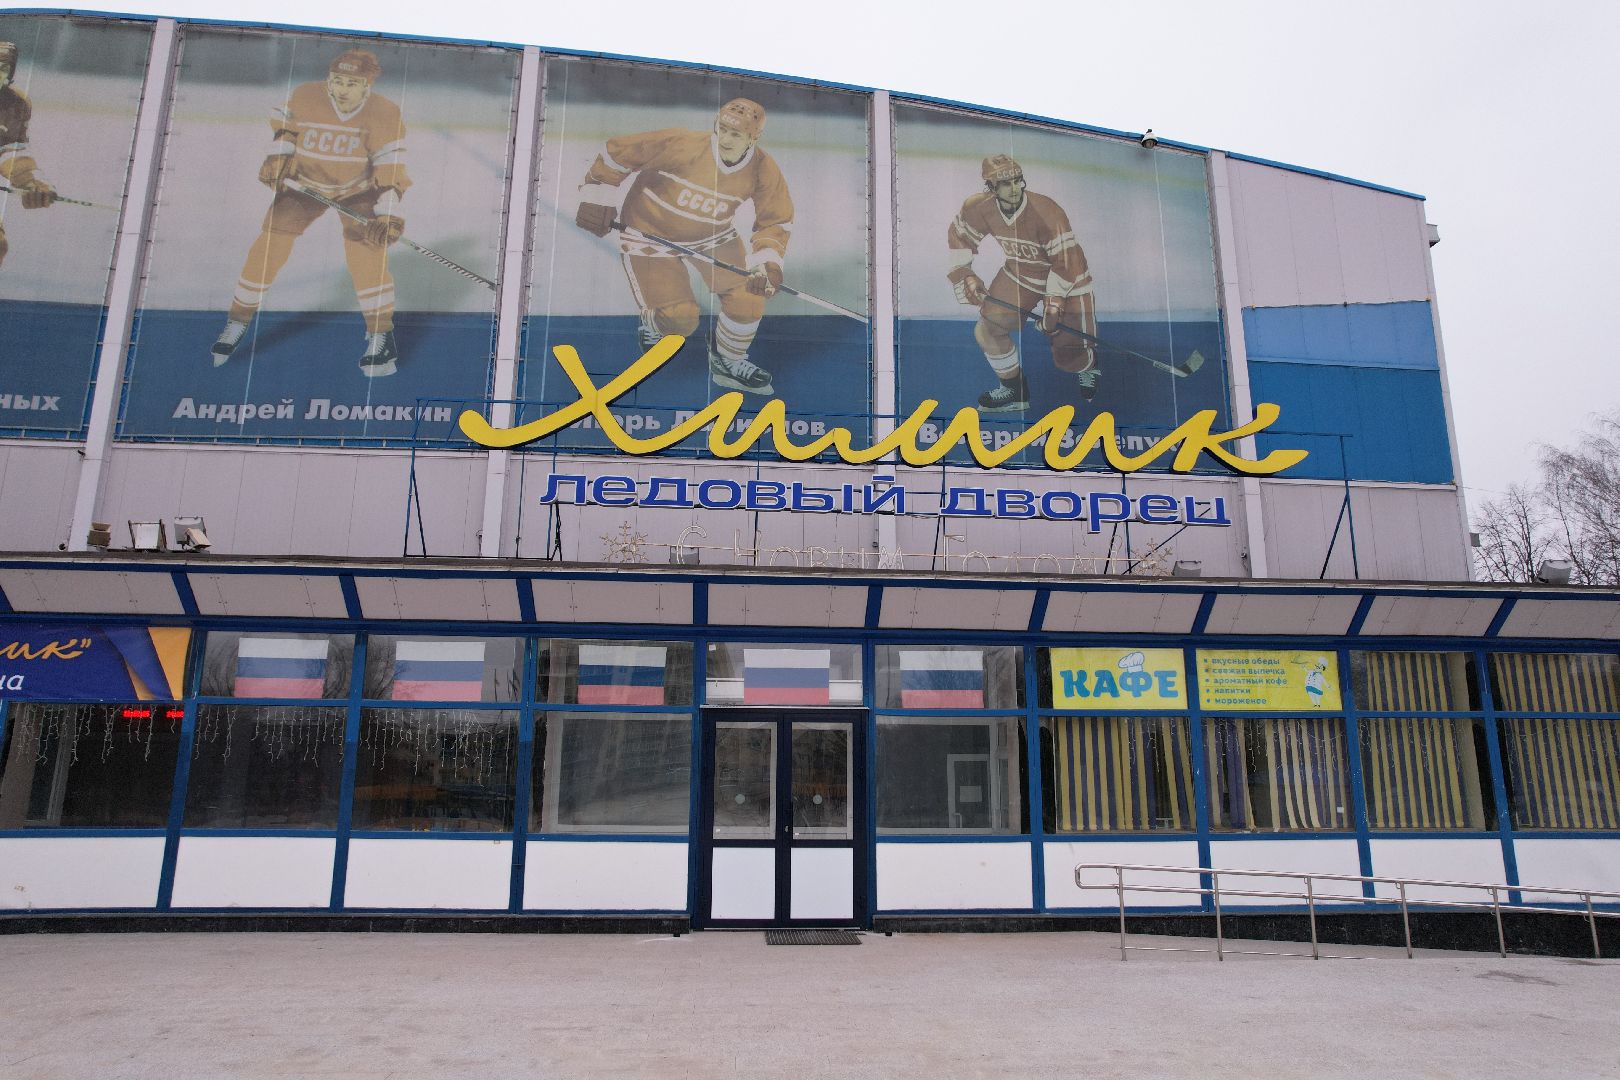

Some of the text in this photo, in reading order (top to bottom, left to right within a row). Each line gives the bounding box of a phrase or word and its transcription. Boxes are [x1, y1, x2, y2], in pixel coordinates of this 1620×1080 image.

[303, 128, 361, 155] СССР
[676, 188, 730, 218] СССР
[1001, 240, 1039, 260] СССР
[171, 397, 452, 425] Андрей Ломакин
[459, 334, 1309, 475] Химик
[540, 474, 1232, 534] ледовый дворец
[1252, 657, 1280, 665] обеды
[1060, 669, 1179, 698] КАФЕ
[1265, 677, 1287, 685] кофе
